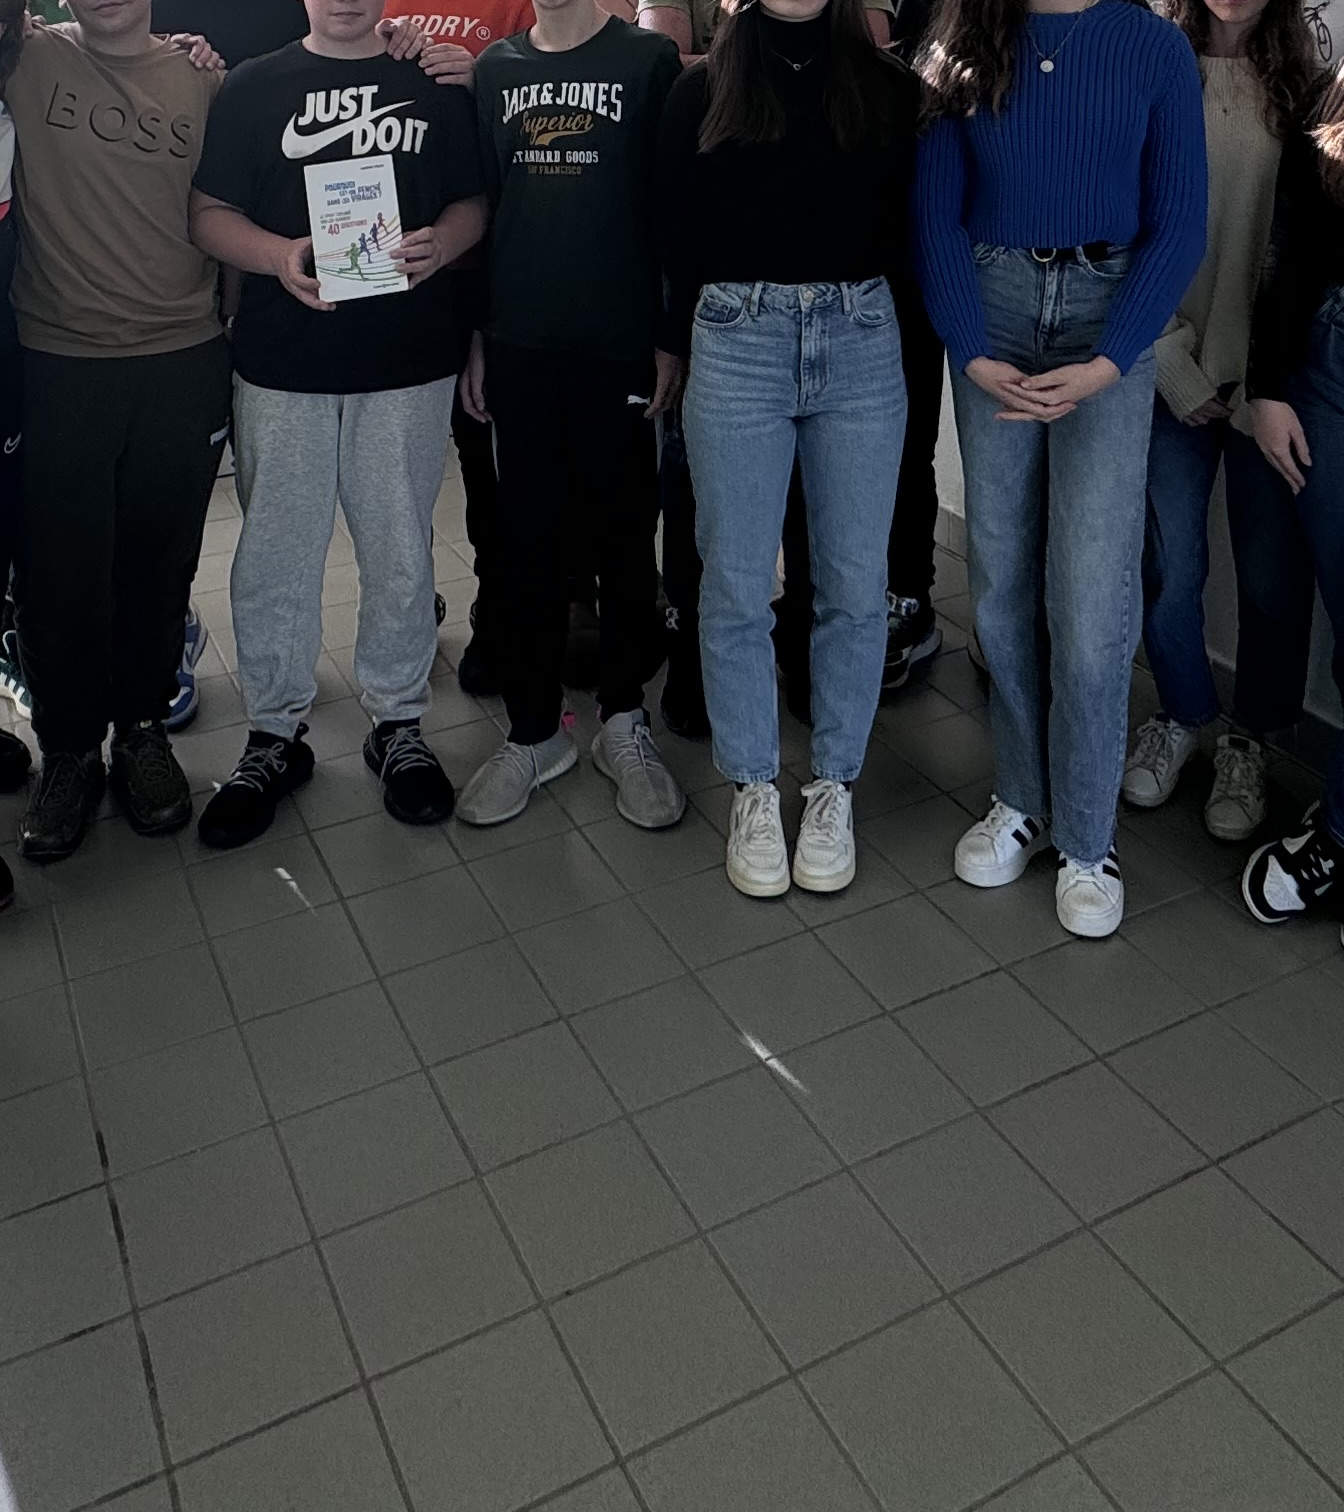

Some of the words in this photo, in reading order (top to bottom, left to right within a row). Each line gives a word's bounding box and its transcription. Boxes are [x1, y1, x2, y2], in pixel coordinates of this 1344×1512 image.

[46, 82, 193, 158] BOSS
[298, 85, 379, 126] JUST
[513, 150, 561, 164] STANDARD
[566, 150, 599, 163] GOODS
